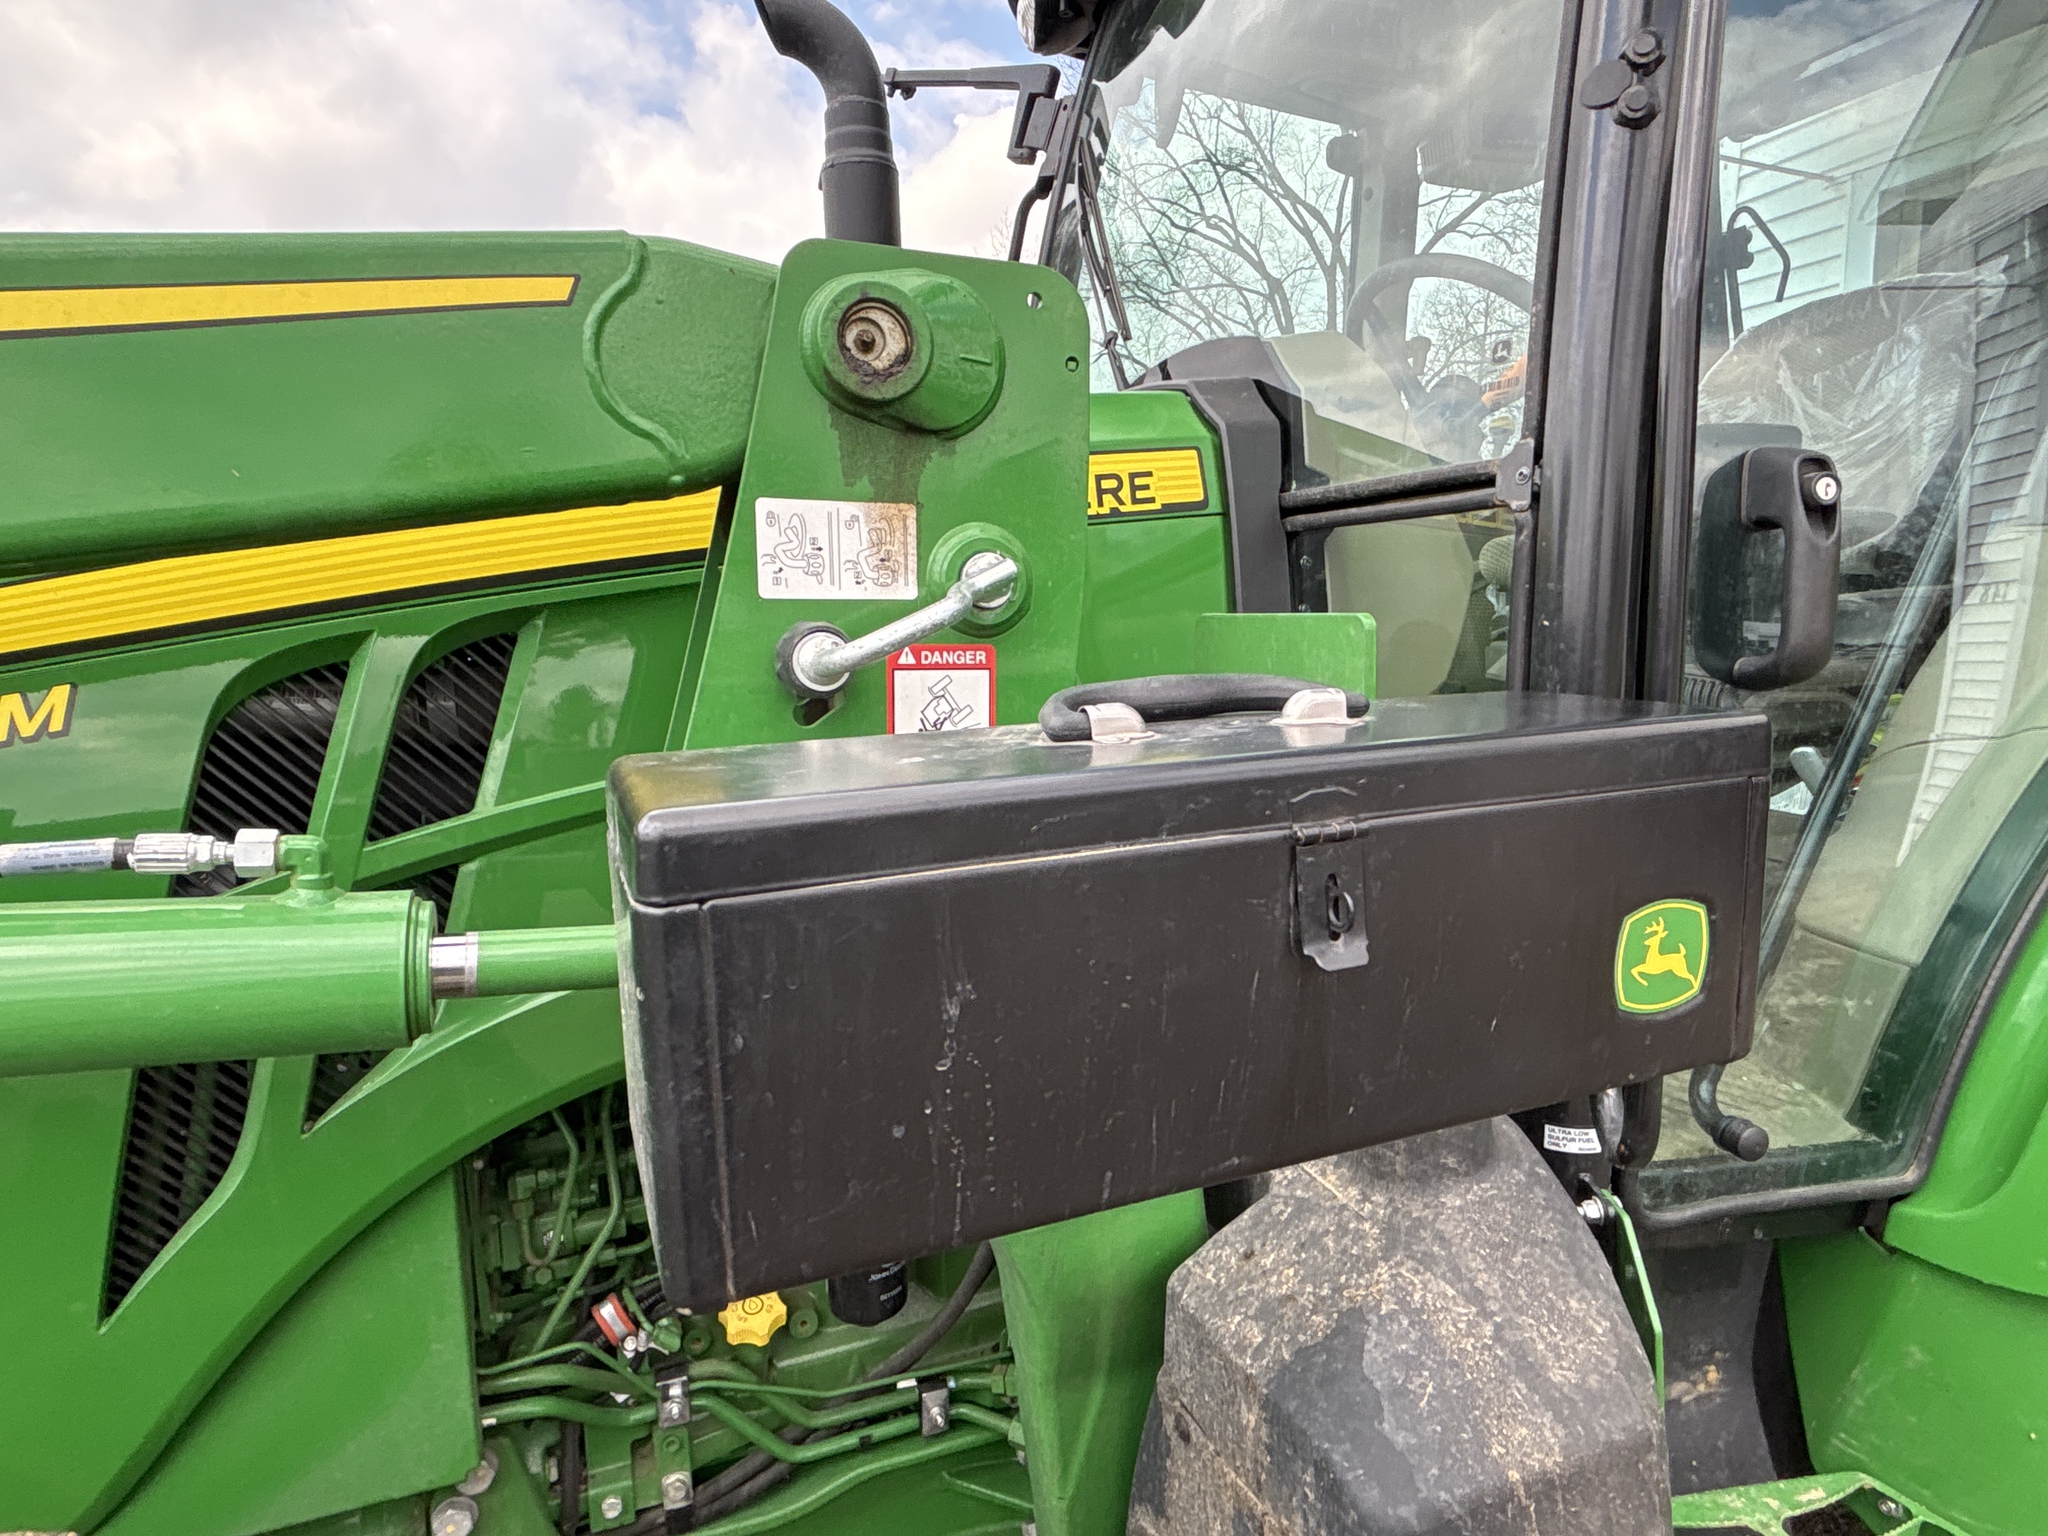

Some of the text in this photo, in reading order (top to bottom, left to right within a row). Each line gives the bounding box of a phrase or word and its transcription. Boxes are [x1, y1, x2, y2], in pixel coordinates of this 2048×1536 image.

[1089, 470, 1156, 508] RE
[920, 650, 987, 665] DANGER
[1548, 1127, 1572, 1136] ULTRA
[1547, 1133, 1577, 1143] SULFUR
